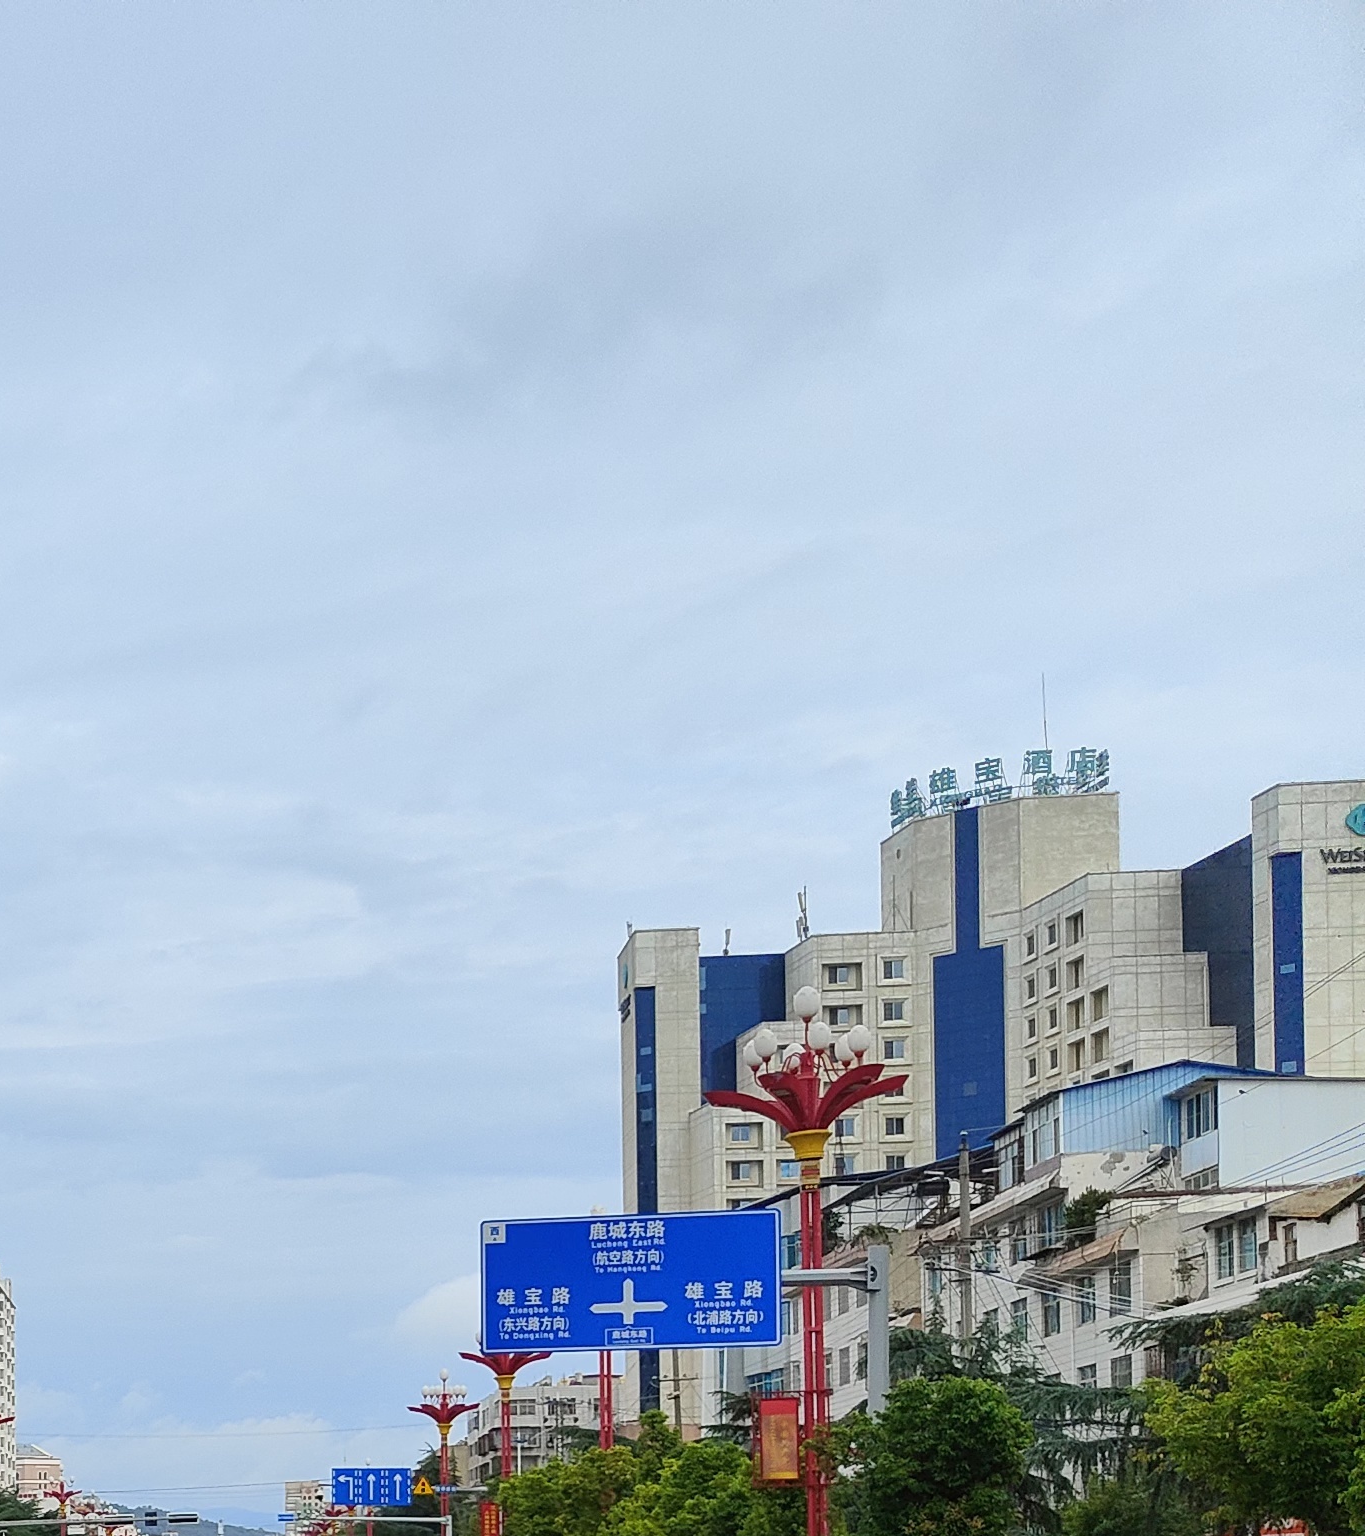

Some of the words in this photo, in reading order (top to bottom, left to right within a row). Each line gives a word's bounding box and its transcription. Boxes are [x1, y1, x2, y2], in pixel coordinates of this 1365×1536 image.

[489, 1226, 500, 1236] 西
[589, 1220, 665, 1240] 鹿城东路
[591, 1240, 628, 1249] Lucheng
[632, 1239, 652, 1247] East
[654, 1237, 666, 1246] Rd.
[592, 1249, 665, 1266] (航空路方向)
[650, 1264, 663, 1272] Rd.
[694, 1299, 736, 1308] Xiongbao
[739, 1298, 753, 1307] Rd.
[509, 1306, 549, 1315] Xiongbao
[552, 1304, 566, 1313] Rd.
[499, 1315, 569, 1332] (东兴路方向)
[687, 1309, 764, 1327] (北浦路方向)
[696, 1326, 707, 1334] To
[710, 1325, 735, 1335] Beipu
[739, 1324, 753, 1333] Rd.
[499, 1331, 510, 1340] To
[513, 1331, 554, 1341] Dongxing
[557, 1330, 571, 1339] Rd.
